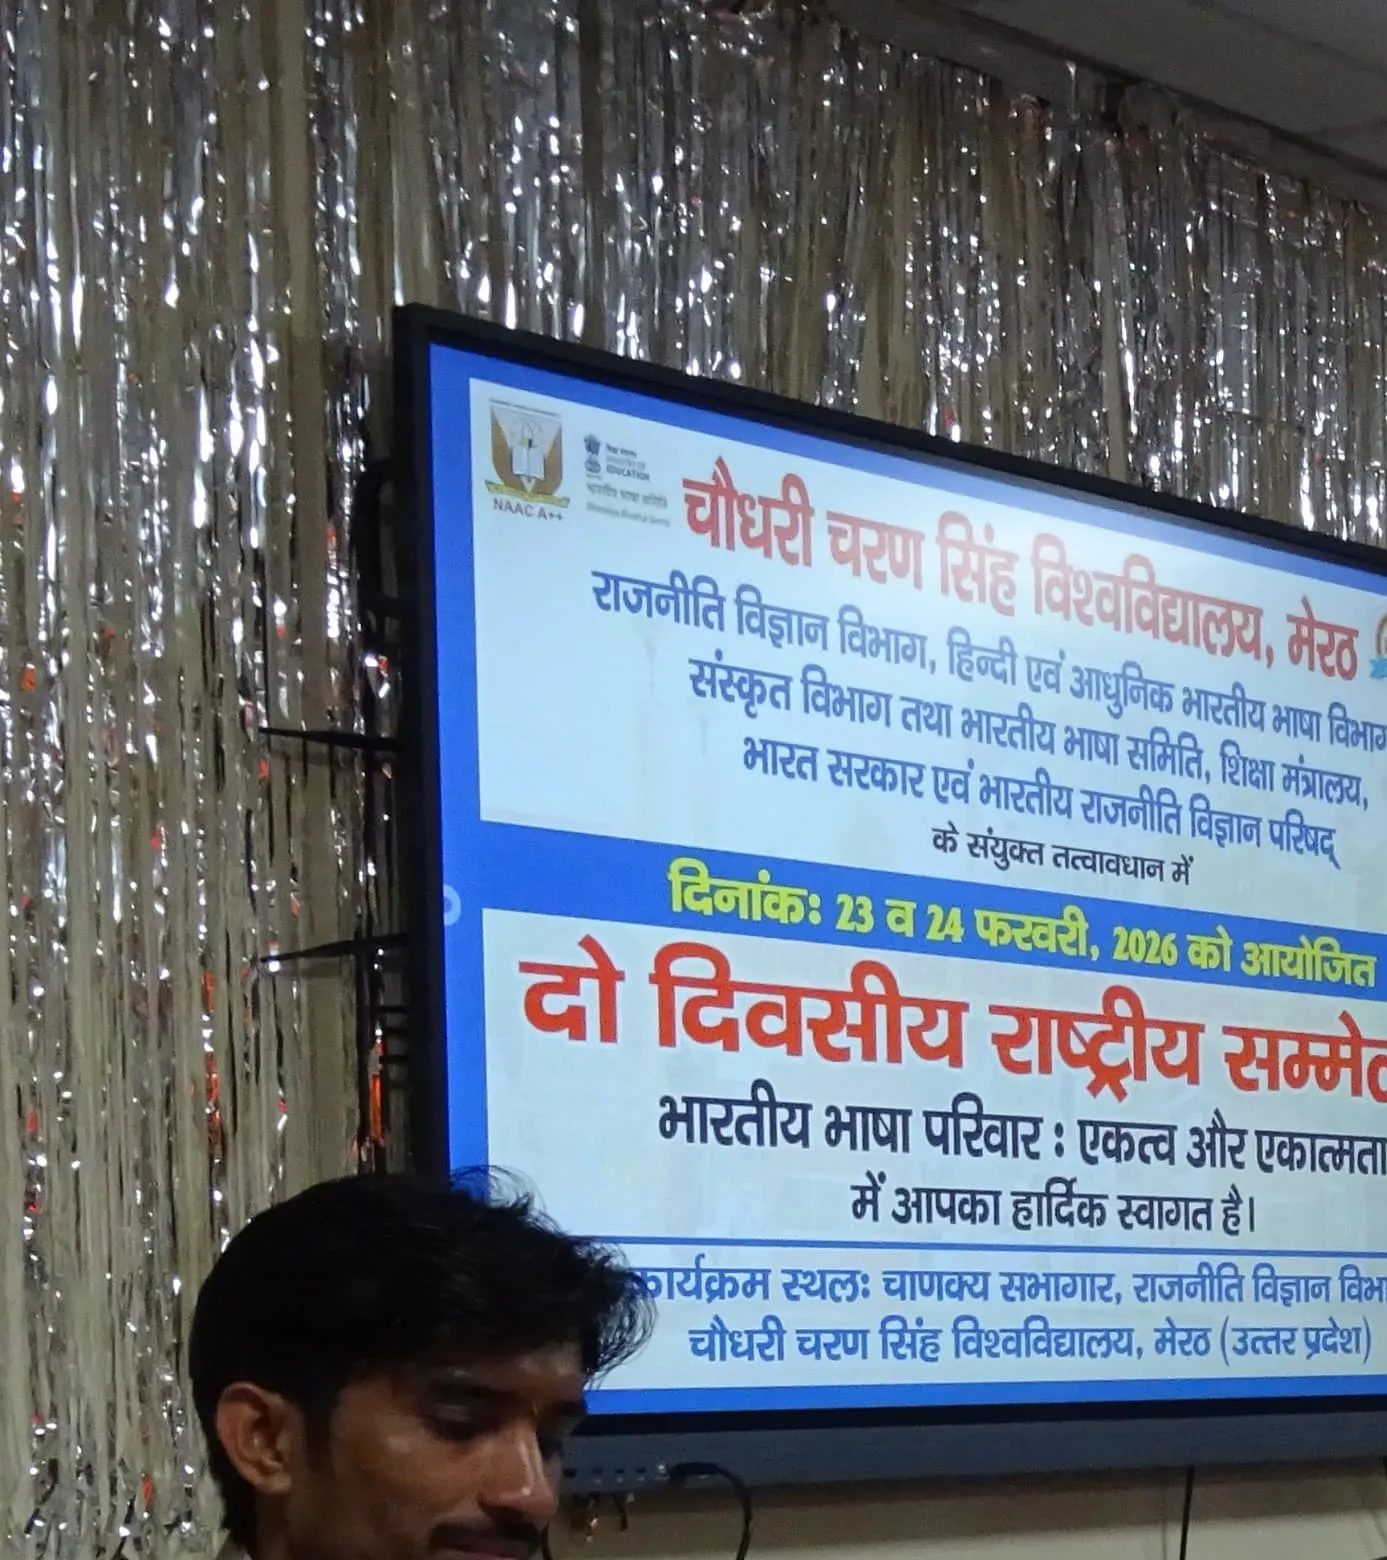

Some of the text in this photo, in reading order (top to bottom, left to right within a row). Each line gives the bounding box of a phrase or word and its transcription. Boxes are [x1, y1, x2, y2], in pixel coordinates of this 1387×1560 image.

[493, 498, 564, 521] NAAC A++
[683, 455, 1359, 681] चौधरी चरण सिंह विश्वविद्यालय, मेरठ
[591, 570, 726, 632] राजनीति
[735, 584, 829, 651] विज्ञान
[838, 604, 935, 675] विभाग,
[947, 626, 1017, 683] हिन्दी
[1026, 649, 1066, 695] एवं
[1068, 661, 1174, 718] आधुनिक
[1182, 681, 1265, 732] भारतीय
[1272, 702, 1321, 743] भाषा
[688, 649, 1368, 811] संस्कृत विभाग तथा भारतीय भाषा समिति, शिक्षा मंत्रालय,
[743, 736, 1342, 870] भारत सरकार एवं भारतीय राजनीति विज्ञान परिषद्
[932, 821, 1194, 887] के संयुक्त तत्वावधान में
[835, 894, 875, 934] 23
[885, 899, 916, 937] व
[925, 905, 964, 944] 24
[975, 904, 1099, 961] फरवरी,
[1112, 926, 1178, 966] 2026
[1187, 926, 1232, 975] को
[1240, 937, 1378, 988] आयोजित
[518, 933, 625, 1045] दो
[648, 940, 970, 1068] दिवसीय
[988, 984, 1206, 1102] राष्ट्रीय
[659, 1078, 813, 1150] भारतीय
[825, 1102, 911, 1155] भाषा
[924, 1091, 1043, 1160] परिवार
[1077, 1118, 1178, 1166] एकत्व
[1186, 1108, 1248, 1170] और
[850, 1170, 1256, 1237] में आपका हार्दिक स्वागत है।
[882, 1270, 990, 1302] चाणक्य
[1000, 1273, 1123, 1306] सभागार,
[1133, 1261, 1245, 1304] राजनीति
[1252, 1262, 1330, 1308] विज्ञान
[688, 1314, 1372, 1366] चौधरी चरण सिंह विश्वविद्यालय, मेरठ (उत्तर प्रदेश)
